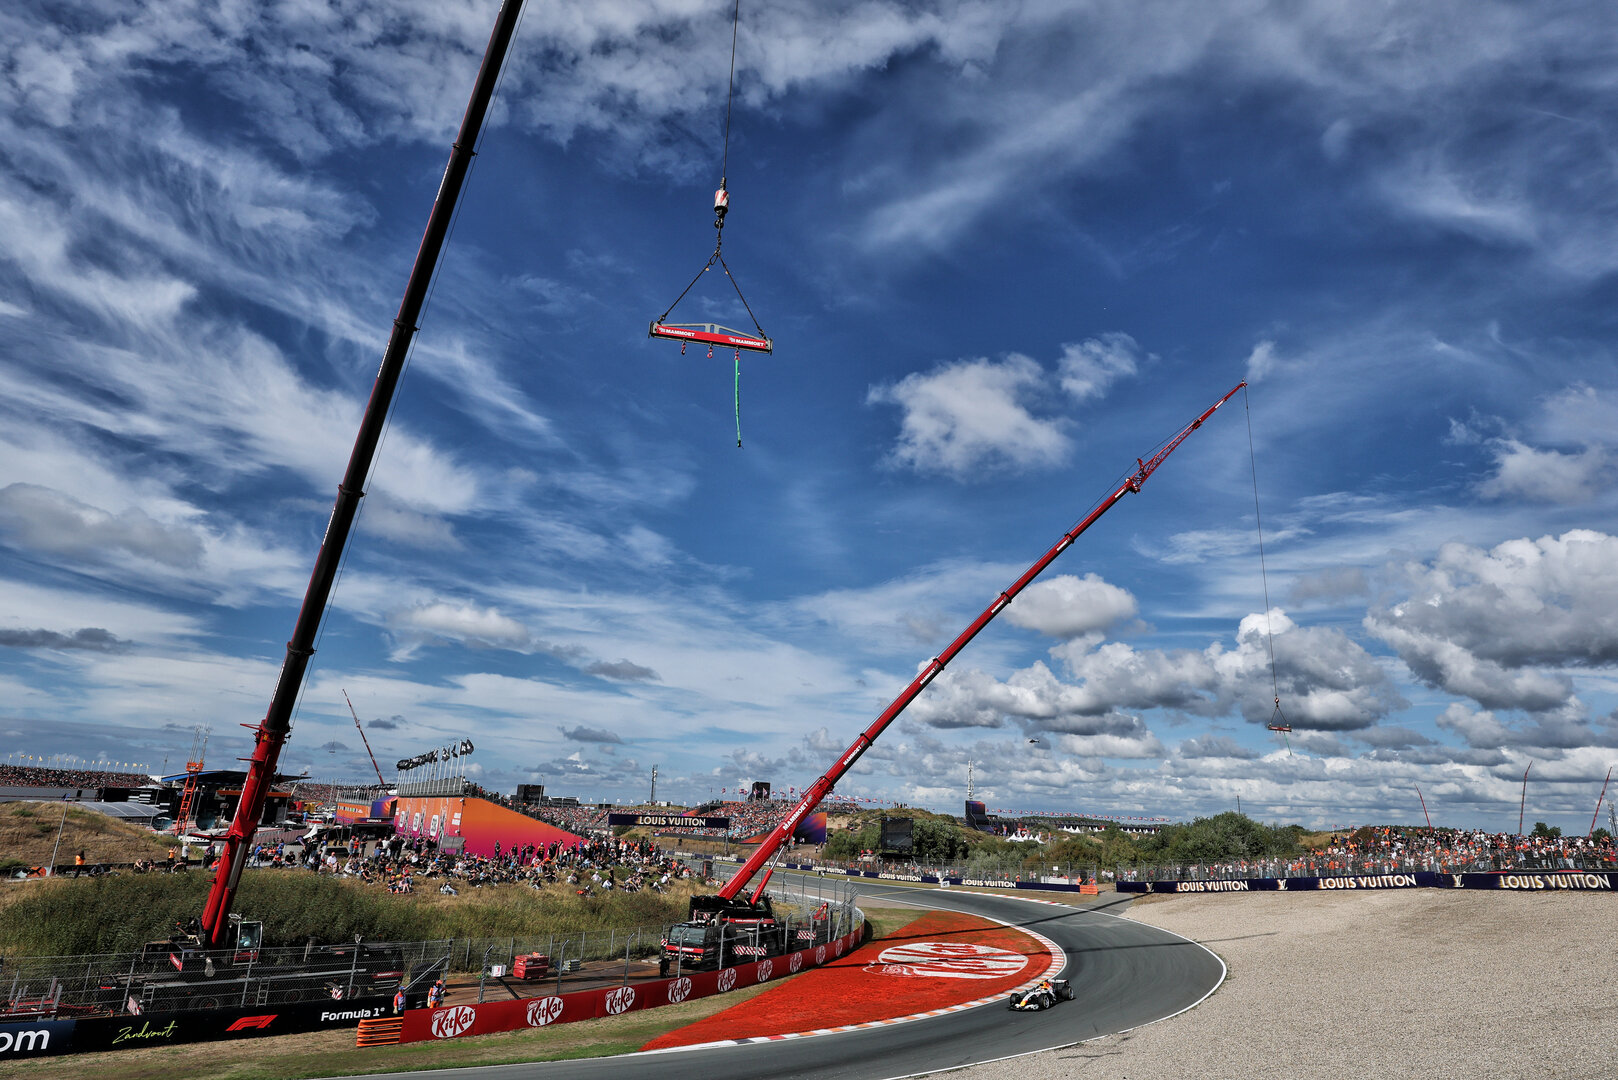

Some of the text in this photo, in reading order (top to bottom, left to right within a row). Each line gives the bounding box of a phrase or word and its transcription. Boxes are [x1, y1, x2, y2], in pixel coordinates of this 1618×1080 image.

[666, 329, 696, 337] MAMMOET
[735, 339, 765, 347] MAMMOET
[843, 745, 862, 766] MAMMOET
[639, 816, 706, 827] LOUIS VUITTON
[782, 801, 809, 831] MAMMOET
[896, 874, 922, 883] VUITTON
[962, 878, 1017, 889] LOUIS VUITTON
[1177, 880, 1249, 892] LOUIS VUITTON
[1319, 874, 1417, 889] LOUIS VUITTON
[1500, 874, 1611, 889] LOUIS VUITTON
[669, 977, 692, 1003] KitKat
[608, 986, 635, 1014] KitKat
[320, 1009, 371, 1022] Formula
[530, 996, 563, 1026] KitKat
[436, 1007, 474, 1037] KitKat
[112, 1020, 178, 1045] Zandvoort
